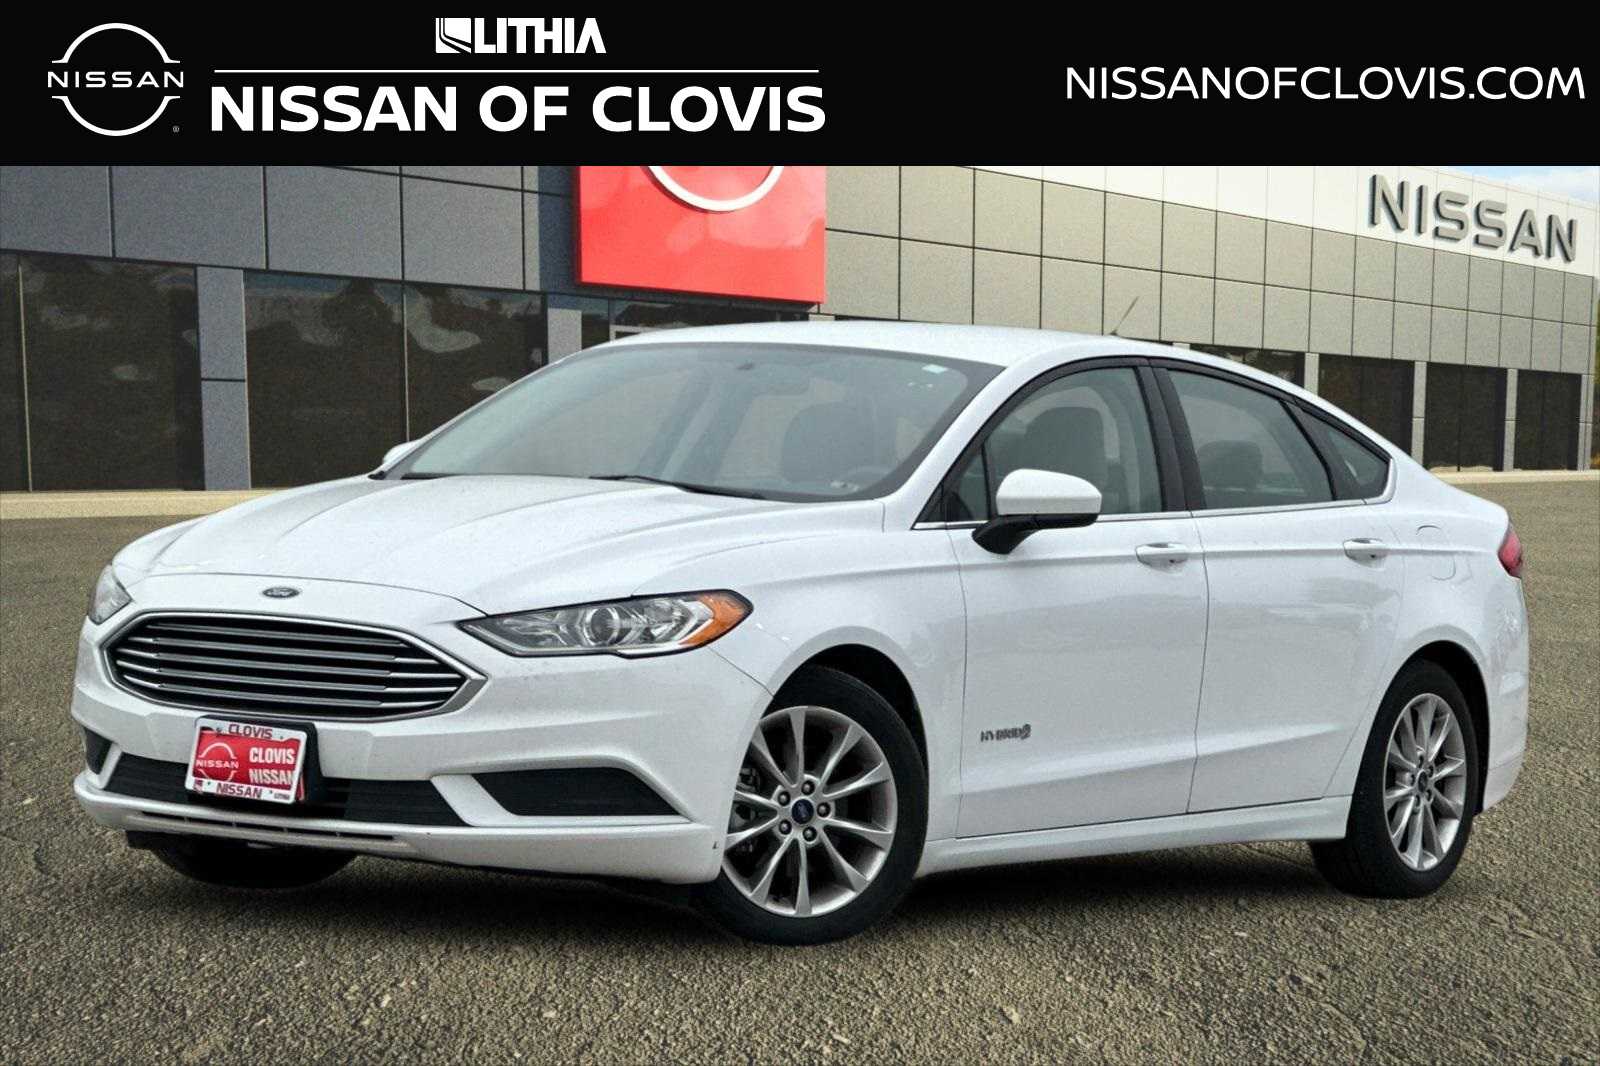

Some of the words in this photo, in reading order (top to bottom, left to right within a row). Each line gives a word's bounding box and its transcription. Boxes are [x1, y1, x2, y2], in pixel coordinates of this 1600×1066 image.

[1368, 173, 1577, 264] NISSAN
[228, 723, 273, 740] CLOVIS
[195, 759, 239, 769] NISSAN
[249, 747, 295, 764] CLOVIS
[216, 782, 263, 799] NISSAN
